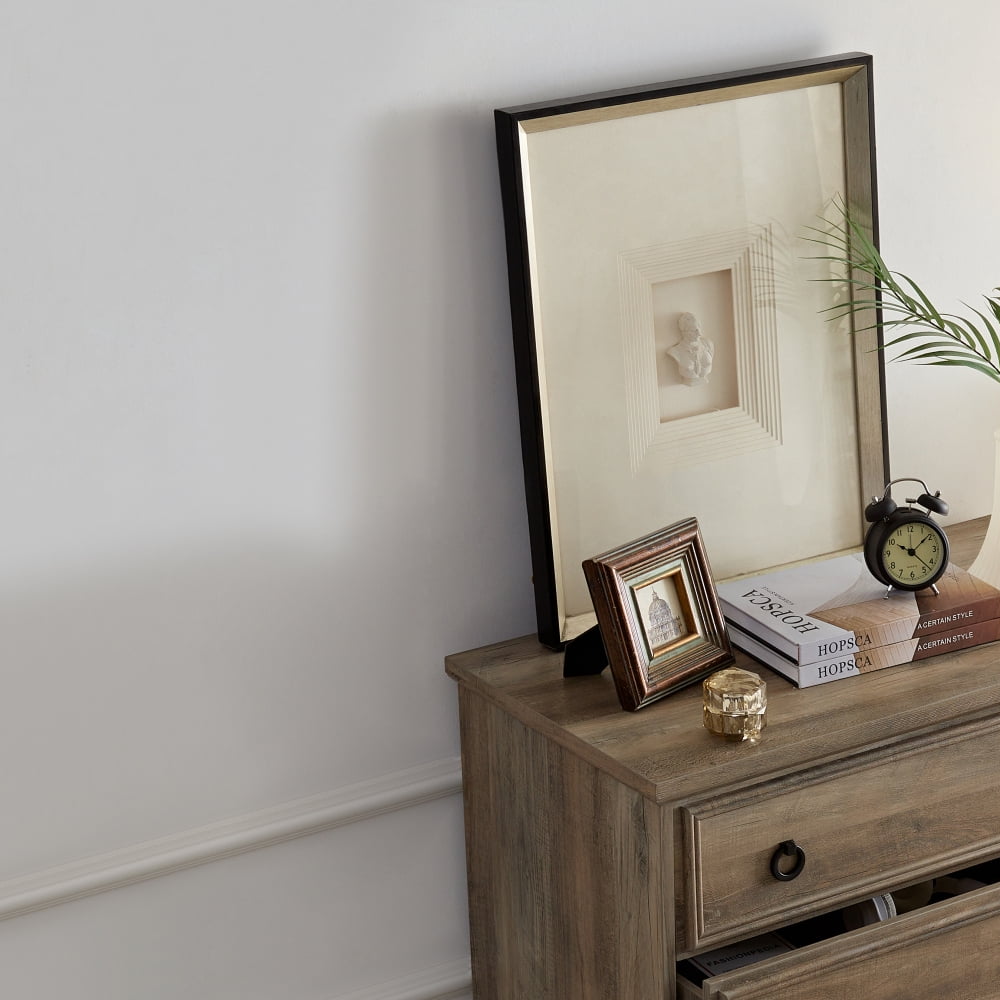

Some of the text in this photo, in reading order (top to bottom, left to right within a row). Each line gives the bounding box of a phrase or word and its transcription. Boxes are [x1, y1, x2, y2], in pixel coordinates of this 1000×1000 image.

[899, 569, 904, 577] 7
[742, 589, 820, 634] HOPSCA
[922, 616, 952, 628] CERTAIN
[952, 610, 974, 620] STYLE
[818, 633, 872, 656] HOPSCA
[922, 637, 952, 650] CERTAIN
[952, 632, 974, 642] STYLE
[818, 656, 873, 678] HOPSCA
